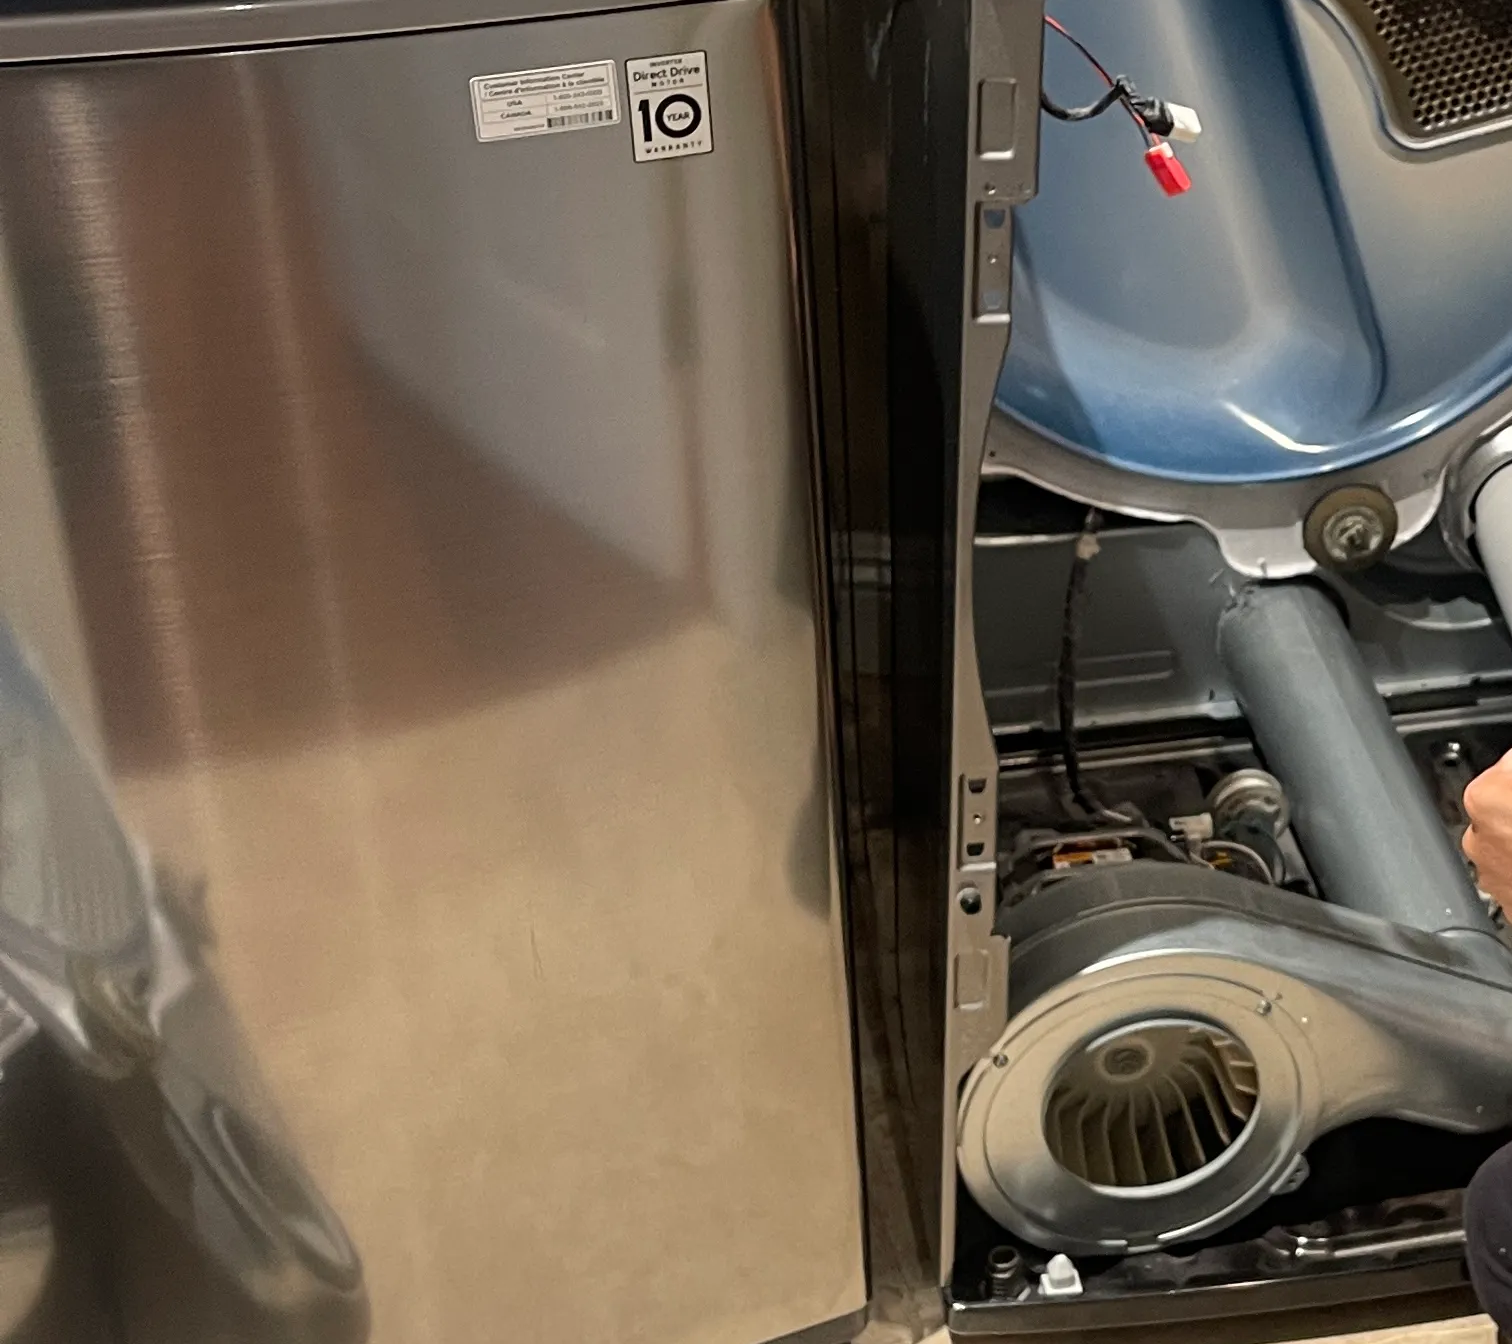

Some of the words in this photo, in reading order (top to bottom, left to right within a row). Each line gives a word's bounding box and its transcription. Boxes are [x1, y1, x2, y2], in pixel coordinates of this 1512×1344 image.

[633, 69, 667, 82] Direct
[670, 66, 700, 77] Drive
[651, 77, 684, 87] MOTOR
[638, 93, 702, 142] 10
[667, 111, 690, 121] YEAR
[645, 140, 702, 154] WARRANTY
